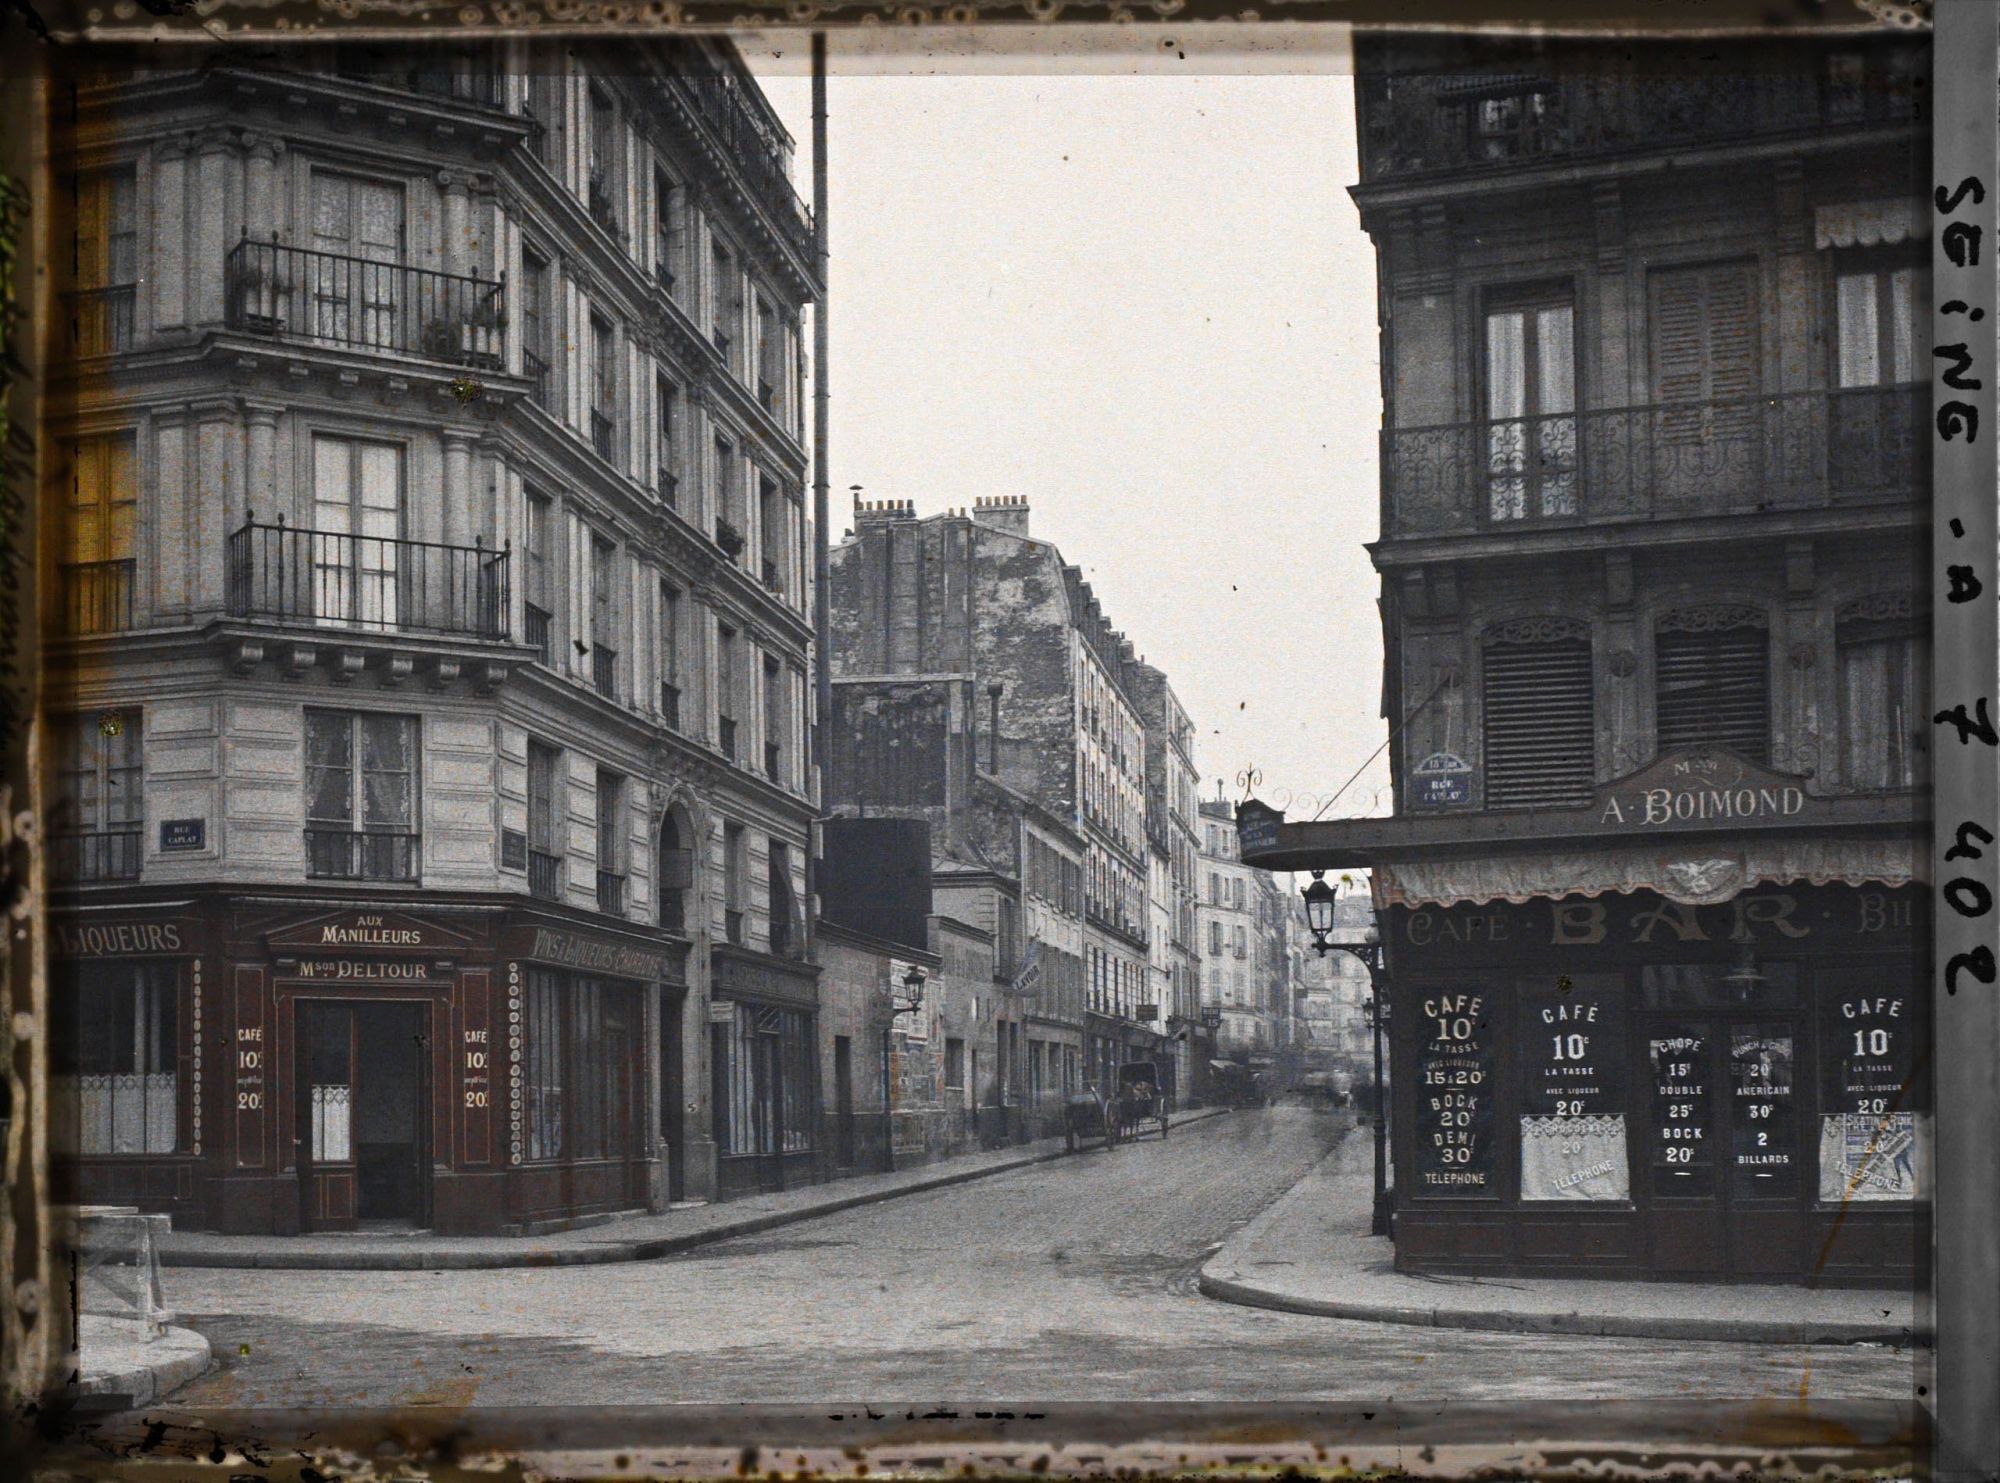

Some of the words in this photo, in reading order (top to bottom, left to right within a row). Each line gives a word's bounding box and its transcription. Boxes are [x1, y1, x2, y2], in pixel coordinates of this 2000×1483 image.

[1639, 786, 1804, 826] BOIMOND
[1943, 820, 1997, 996] 402
[357, 916, 384, 927] AUX
[1550, 893, 1810, 945] BAR
[321, 925, 421, 944] MANILLEURS
[336, 960, 427, 979] DELTOUR
[238, 1025, 262, 1042] CAFÉ
[464, 1027, 487, 1044] CAFÉ
[1429, 1042, 1440, 1052] LA
[1445, 1041, 1479, 1054] TASSE
[1731, 1041, 1760, 1059] PUNCH
[1425, 1071, 1446, 1085] 15
[1545, 1068, 1558, 1076] LA
[1562, 1067, 1594, 1075] TASSE
[1568, 1087, 1600, 1095] LIQUEUR
[1660, 1085, 1703, 1095] DOUBLE
[1869, 1084, 1902, 1092] LIQUEUR
[1431, 1094, 1478, 1111] BOCK
[1433, 1131, 1476, 1147] DEMI
[1663, 1128, 1702, 1139] BOCK
[1757, 1132, 1768, 1146] 2
[1738, 1154, 1790, 1164] BILLARDS
